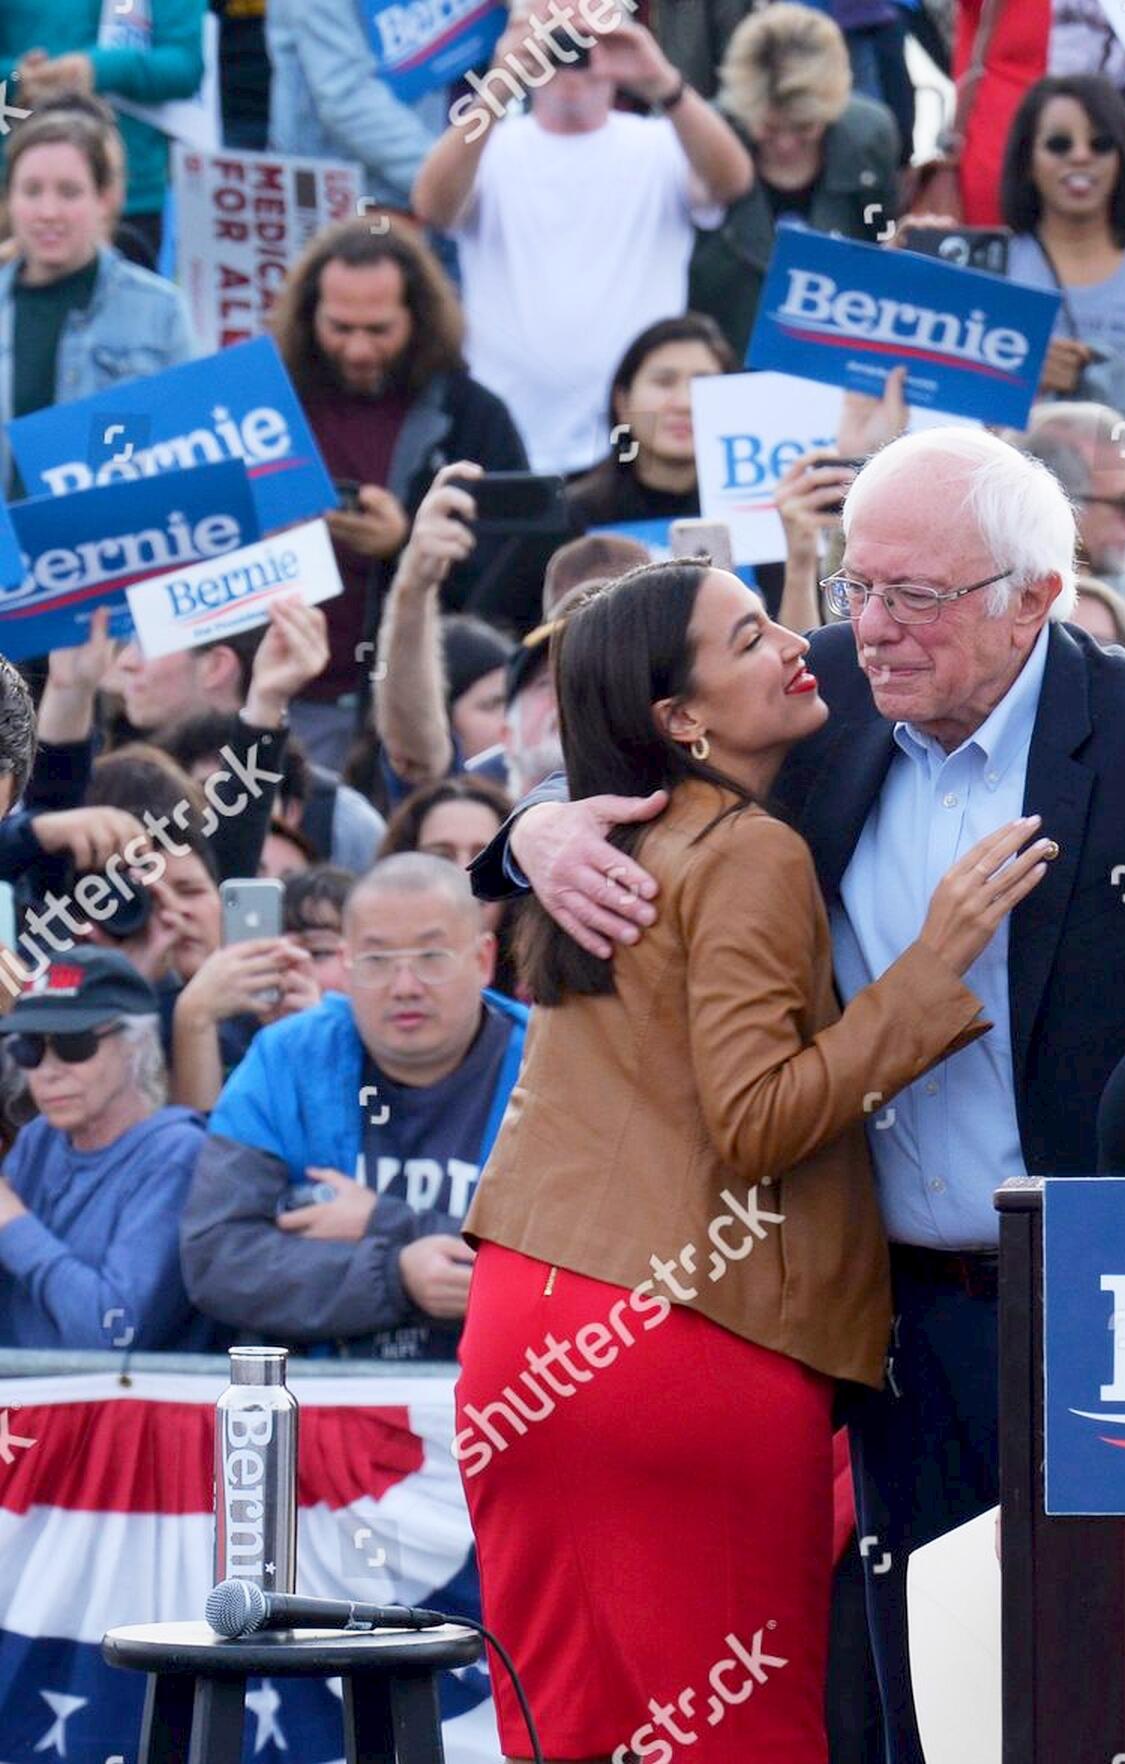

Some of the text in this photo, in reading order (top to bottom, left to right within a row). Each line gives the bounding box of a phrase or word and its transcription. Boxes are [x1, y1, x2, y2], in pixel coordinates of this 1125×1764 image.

[212, 158, 249, 242] FOR
[774, 267, 1030, 373] Bernie
[719, 433, 837, 491] Be
[0, 510, 242, 600] ernie
[163, 548, 299, 619] Bernie
